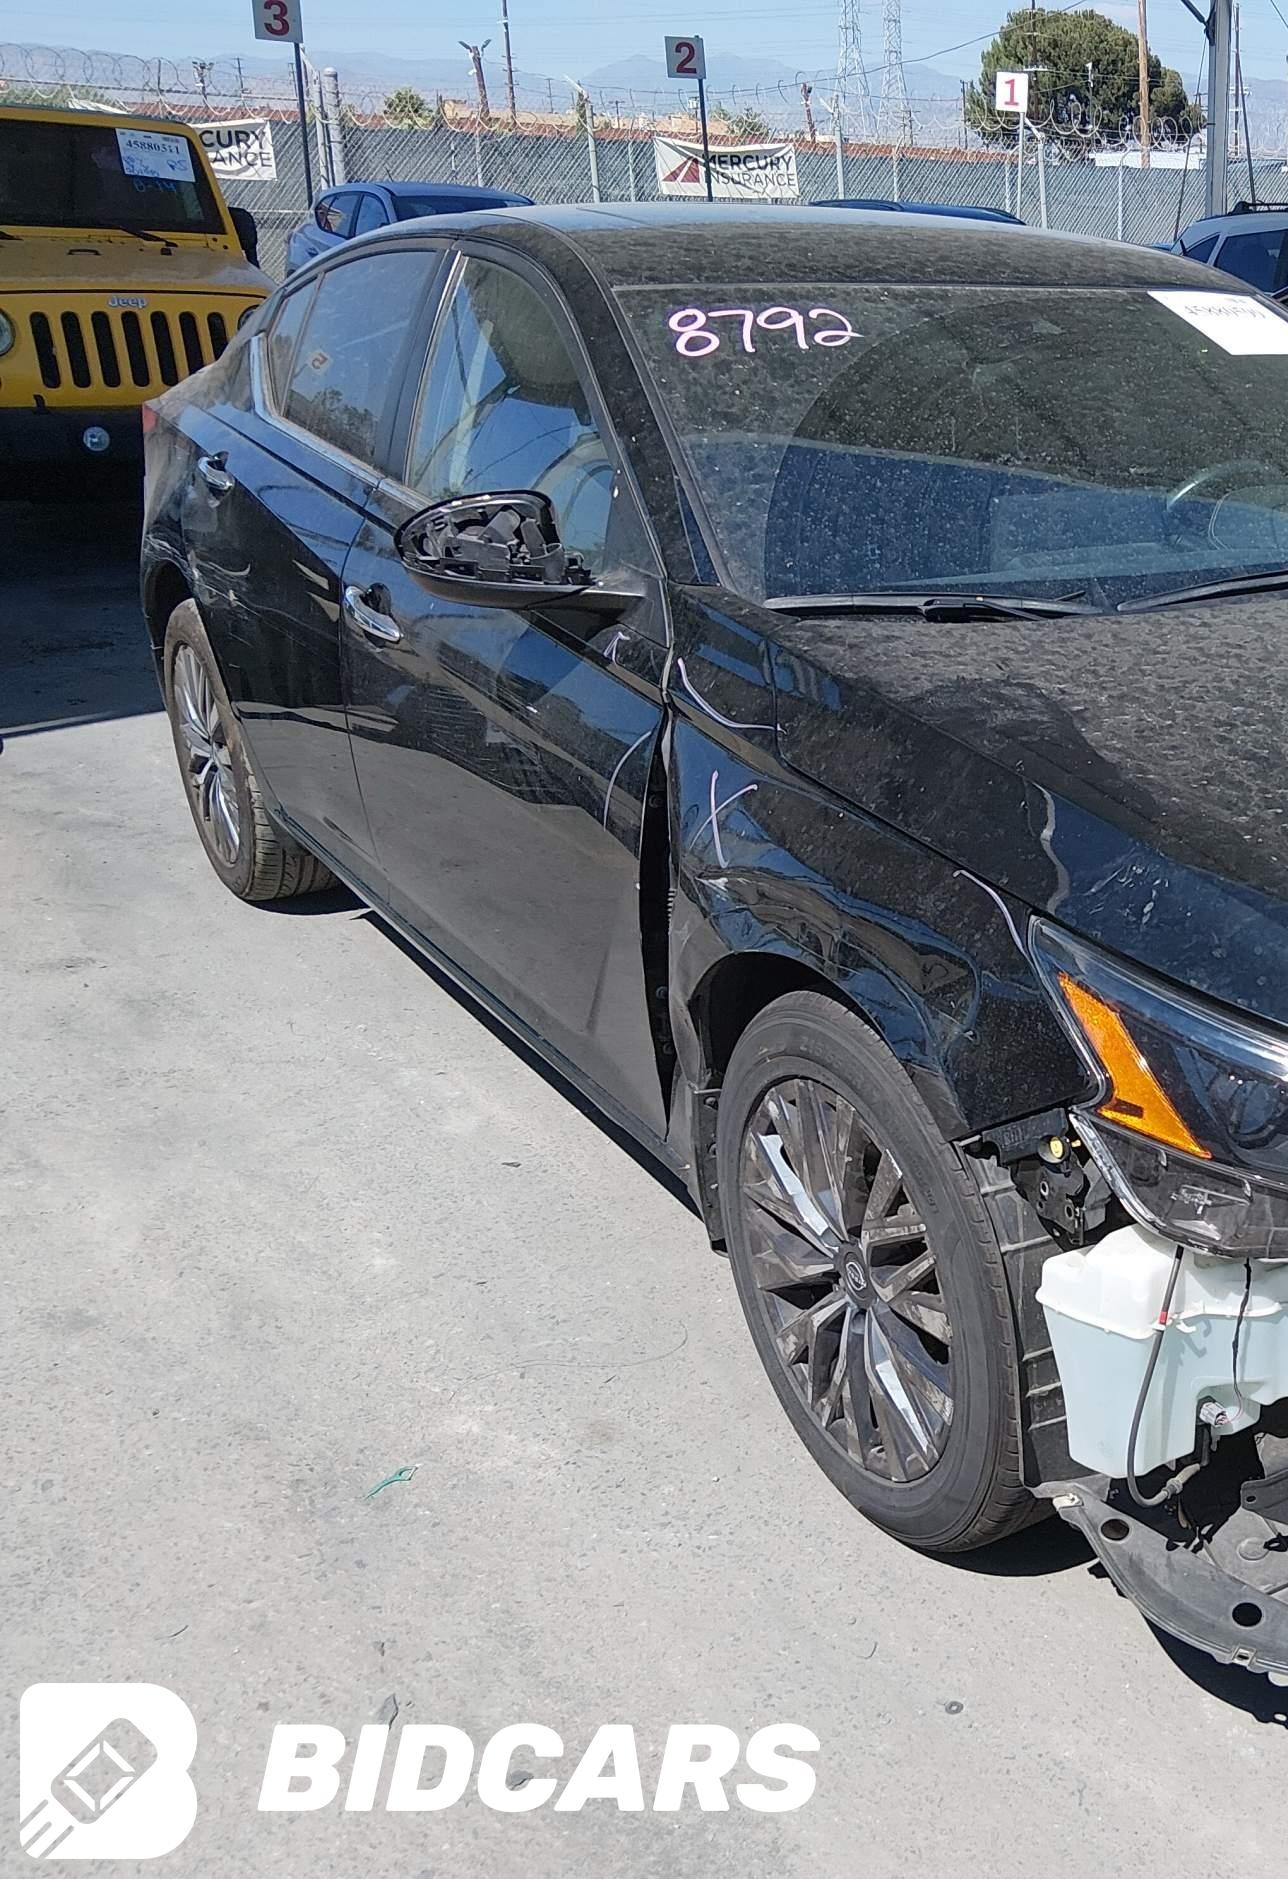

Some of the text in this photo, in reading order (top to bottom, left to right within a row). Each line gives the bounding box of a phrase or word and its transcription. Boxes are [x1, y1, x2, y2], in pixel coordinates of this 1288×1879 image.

[263, 0, 290, 36] 3
[675, 41, 698, 74] 2
[1004, 79, 1019, 106] 1
[199, 129, 266, 150] CURY
[108, 295, 148, 309] Jeep
[668, 306, 865, 357] 8792
